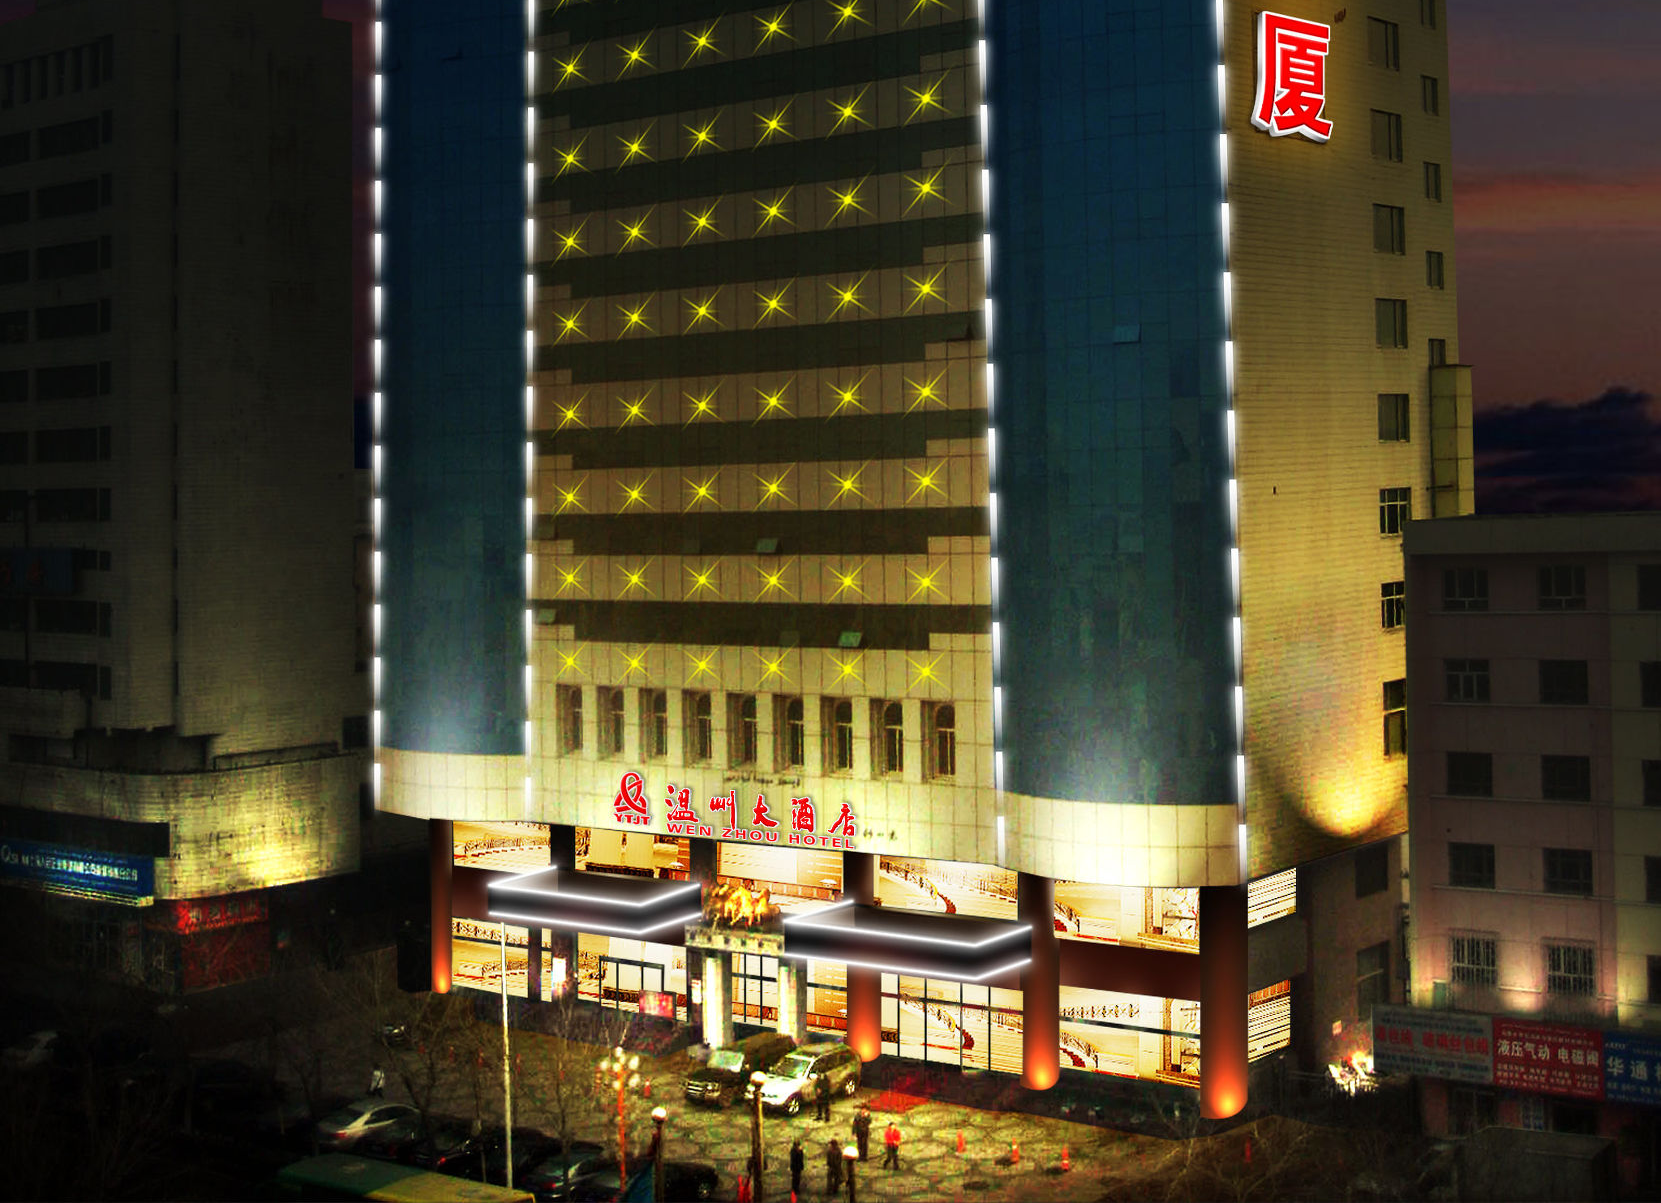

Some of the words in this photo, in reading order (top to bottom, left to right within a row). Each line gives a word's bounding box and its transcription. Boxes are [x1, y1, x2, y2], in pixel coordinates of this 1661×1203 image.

[613, 813, 651, 826] YTJT
[664, 784, 857, 837] 温州大酒店
[666, 823, 712, 837] WEN
[722, 828, 779, 842] ZHOU
[788, 834, 856, 850] HOTEL
[1497, 1038, 1551, 1062] 液压气动
